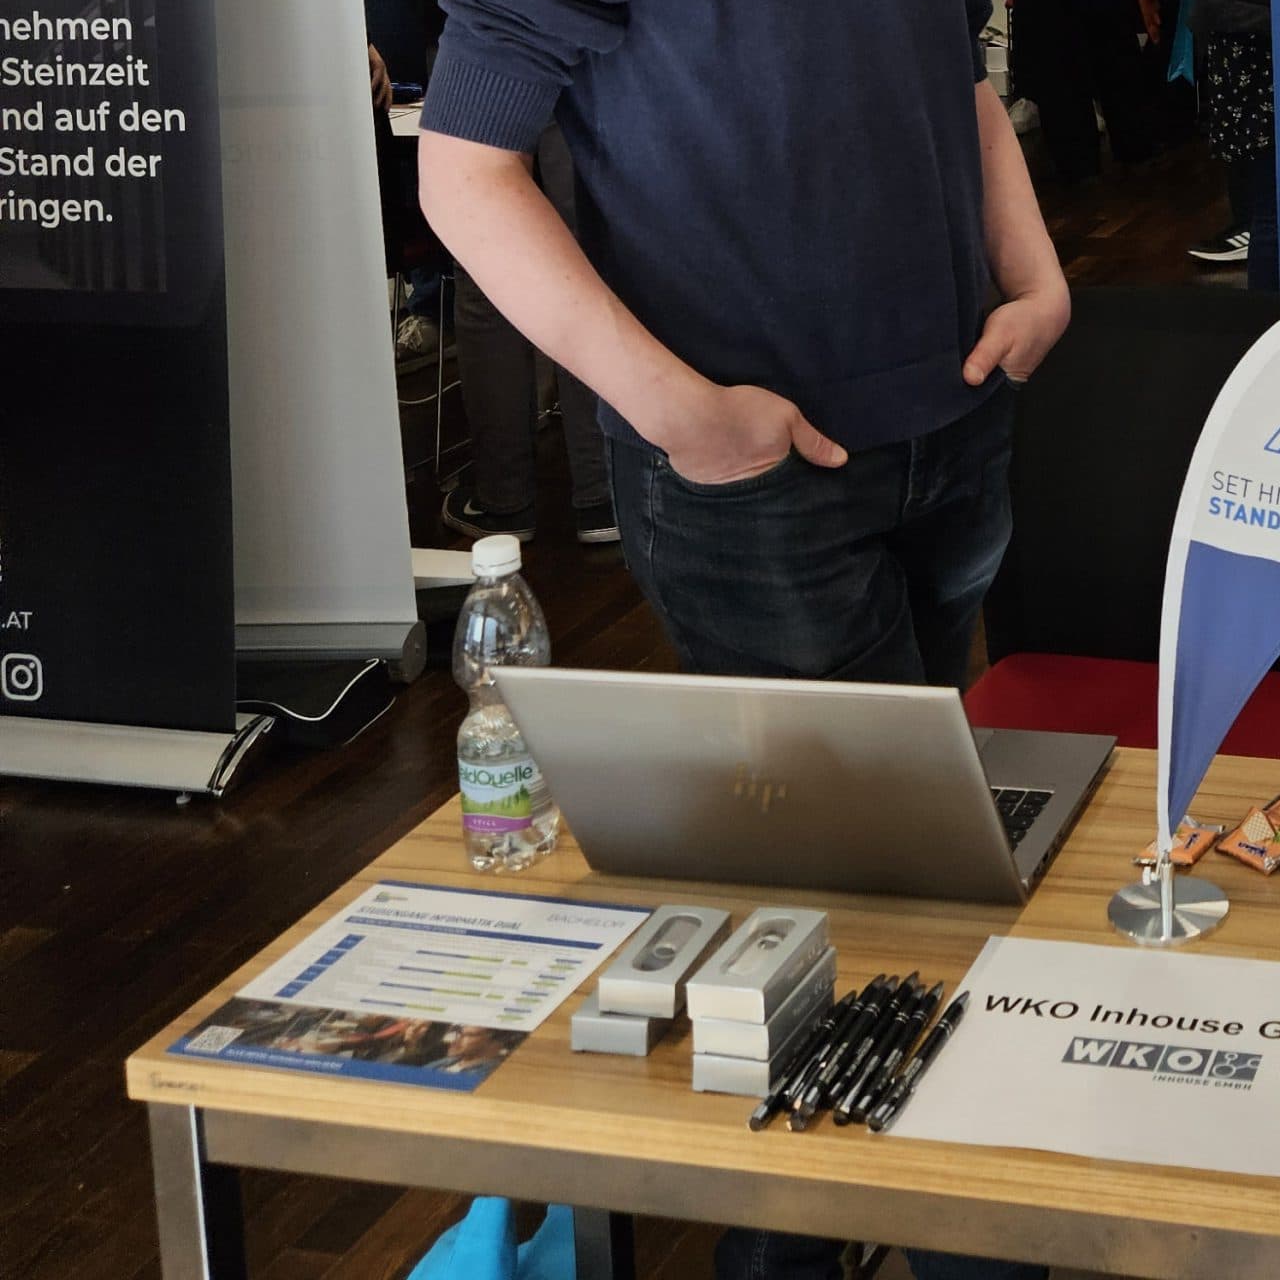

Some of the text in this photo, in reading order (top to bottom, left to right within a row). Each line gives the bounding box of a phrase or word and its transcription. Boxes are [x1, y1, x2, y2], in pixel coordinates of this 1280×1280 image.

[2, 56, 149, 87] Steinzeit
[55, 101, 110, 131] auf
[119, 102, 186, 131] den
[0, 147, 162, 177] Stand der
[1211, 471, 1253, 498] SET
[983, 994, 1080, 1020] WKO
[1090, 1004, 1244, 1036] Inhouse
[1073, 1038, 1203, 1072] WKO
[1152, 1075, 1210, 1087] INHOUSE
